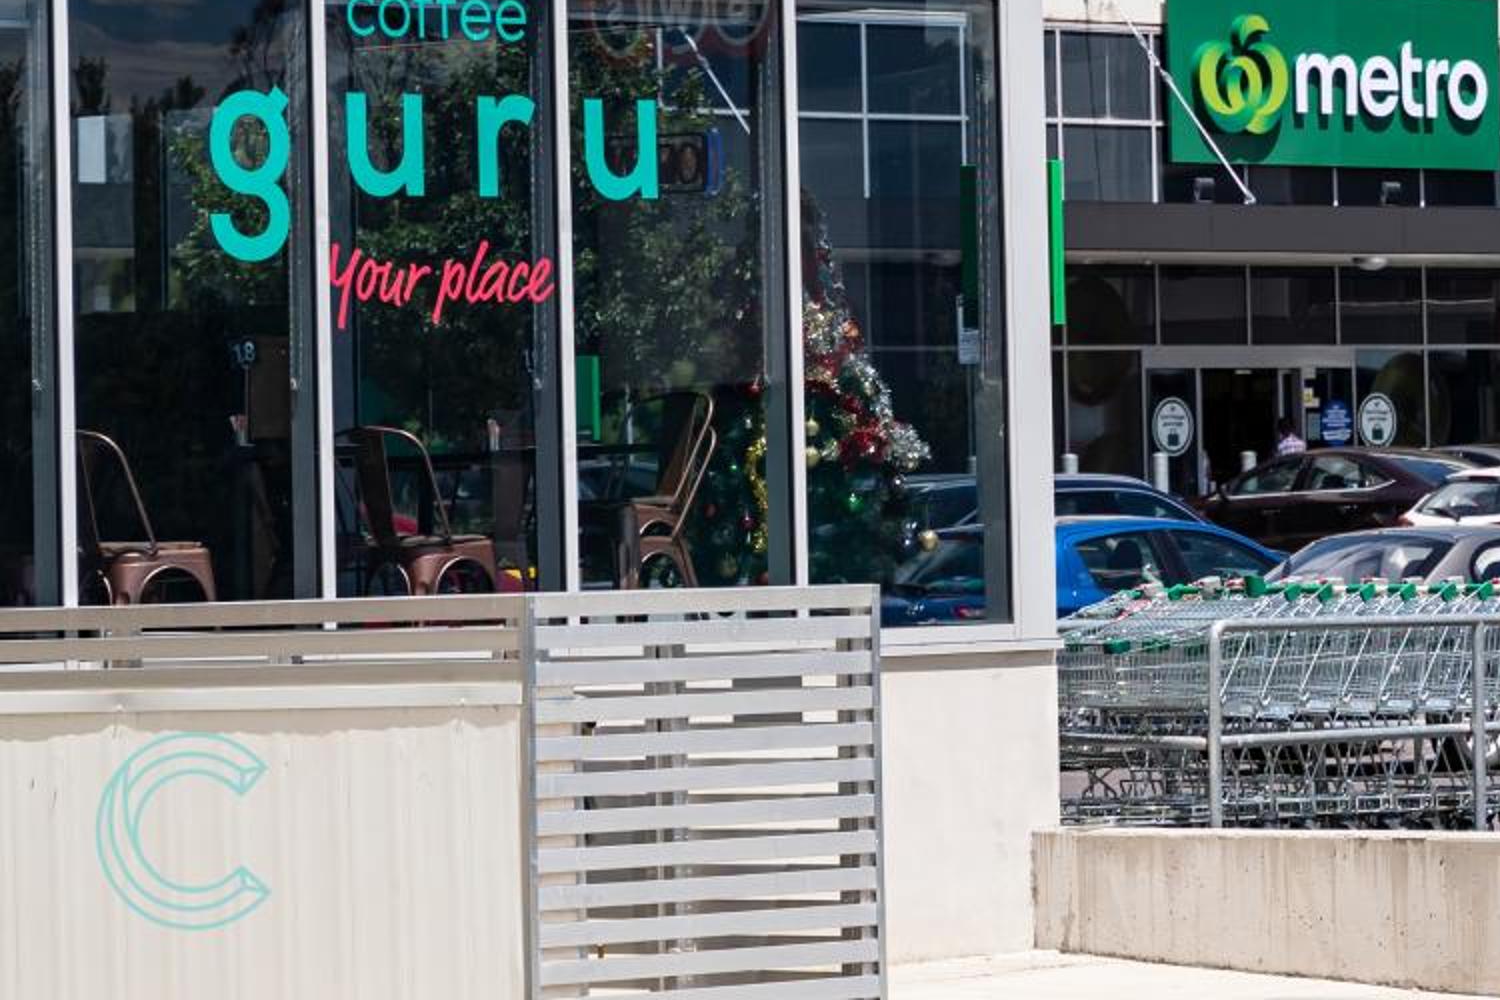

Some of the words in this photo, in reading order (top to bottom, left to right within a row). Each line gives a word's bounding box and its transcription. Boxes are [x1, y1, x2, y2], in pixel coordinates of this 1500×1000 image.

[1294, 40, 1489, 121] metro
[209, 85, 660, 262] guru
[330, 241, 431, 330] Your
[431, 240, 556, 324] place
